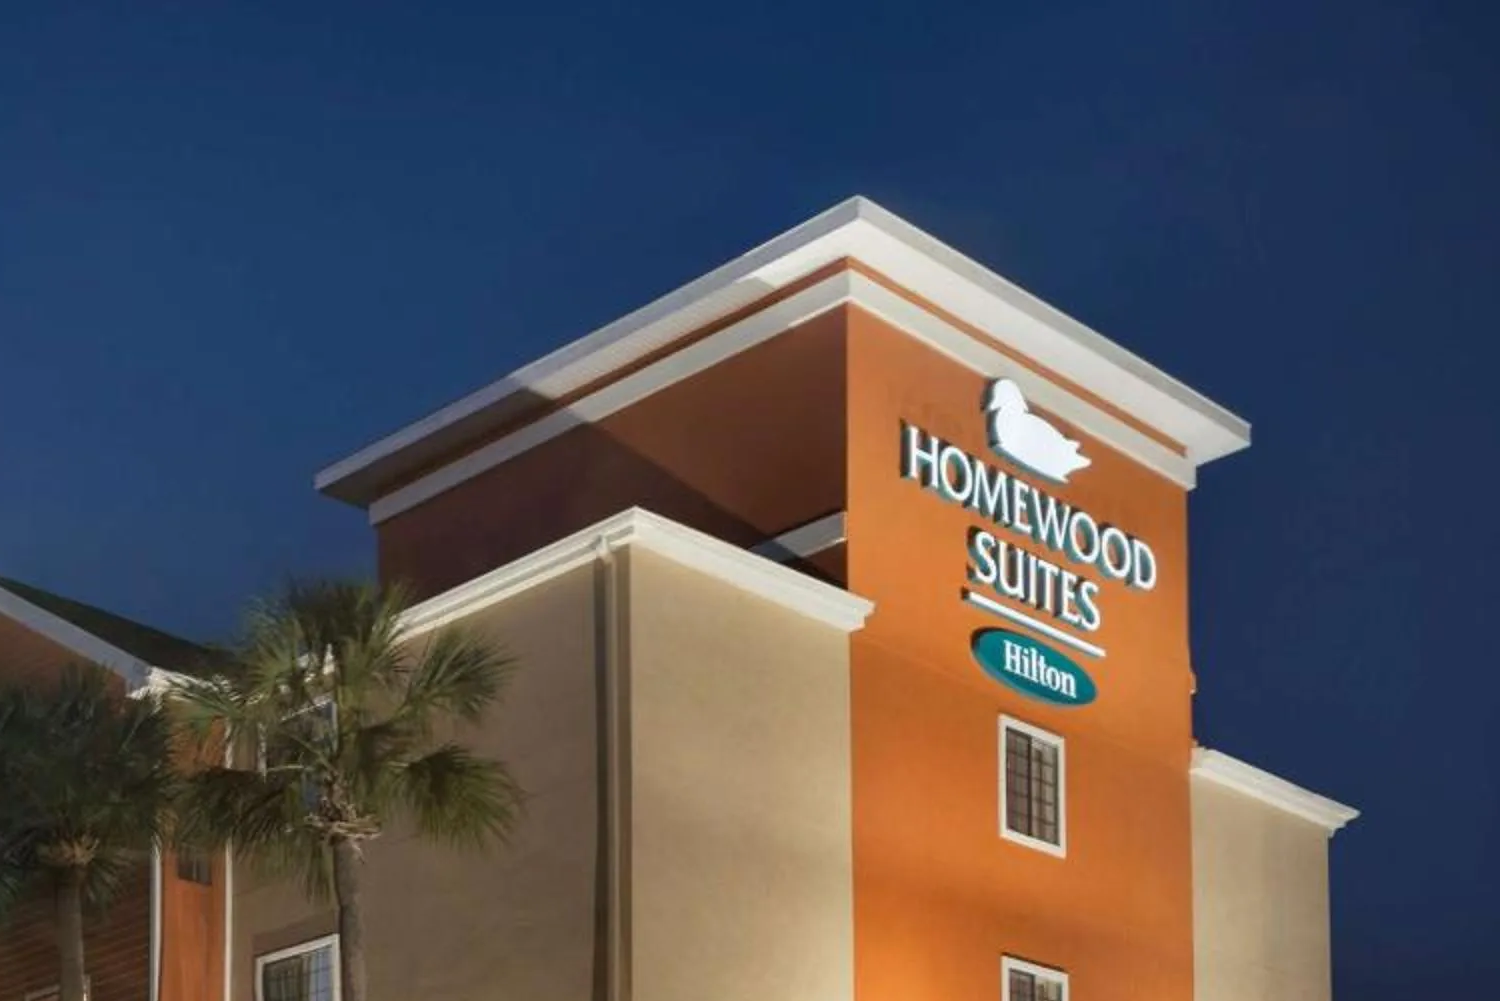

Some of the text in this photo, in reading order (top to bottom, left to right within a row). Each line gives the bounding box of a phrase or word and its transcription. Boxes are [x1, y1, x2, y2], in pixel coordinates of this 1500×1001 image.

[903, 423, 1158, 590] HOMEWOOD
[970, 530, 1102, 632] SUITES
[1003, 639, 1078, 699] Hilton
